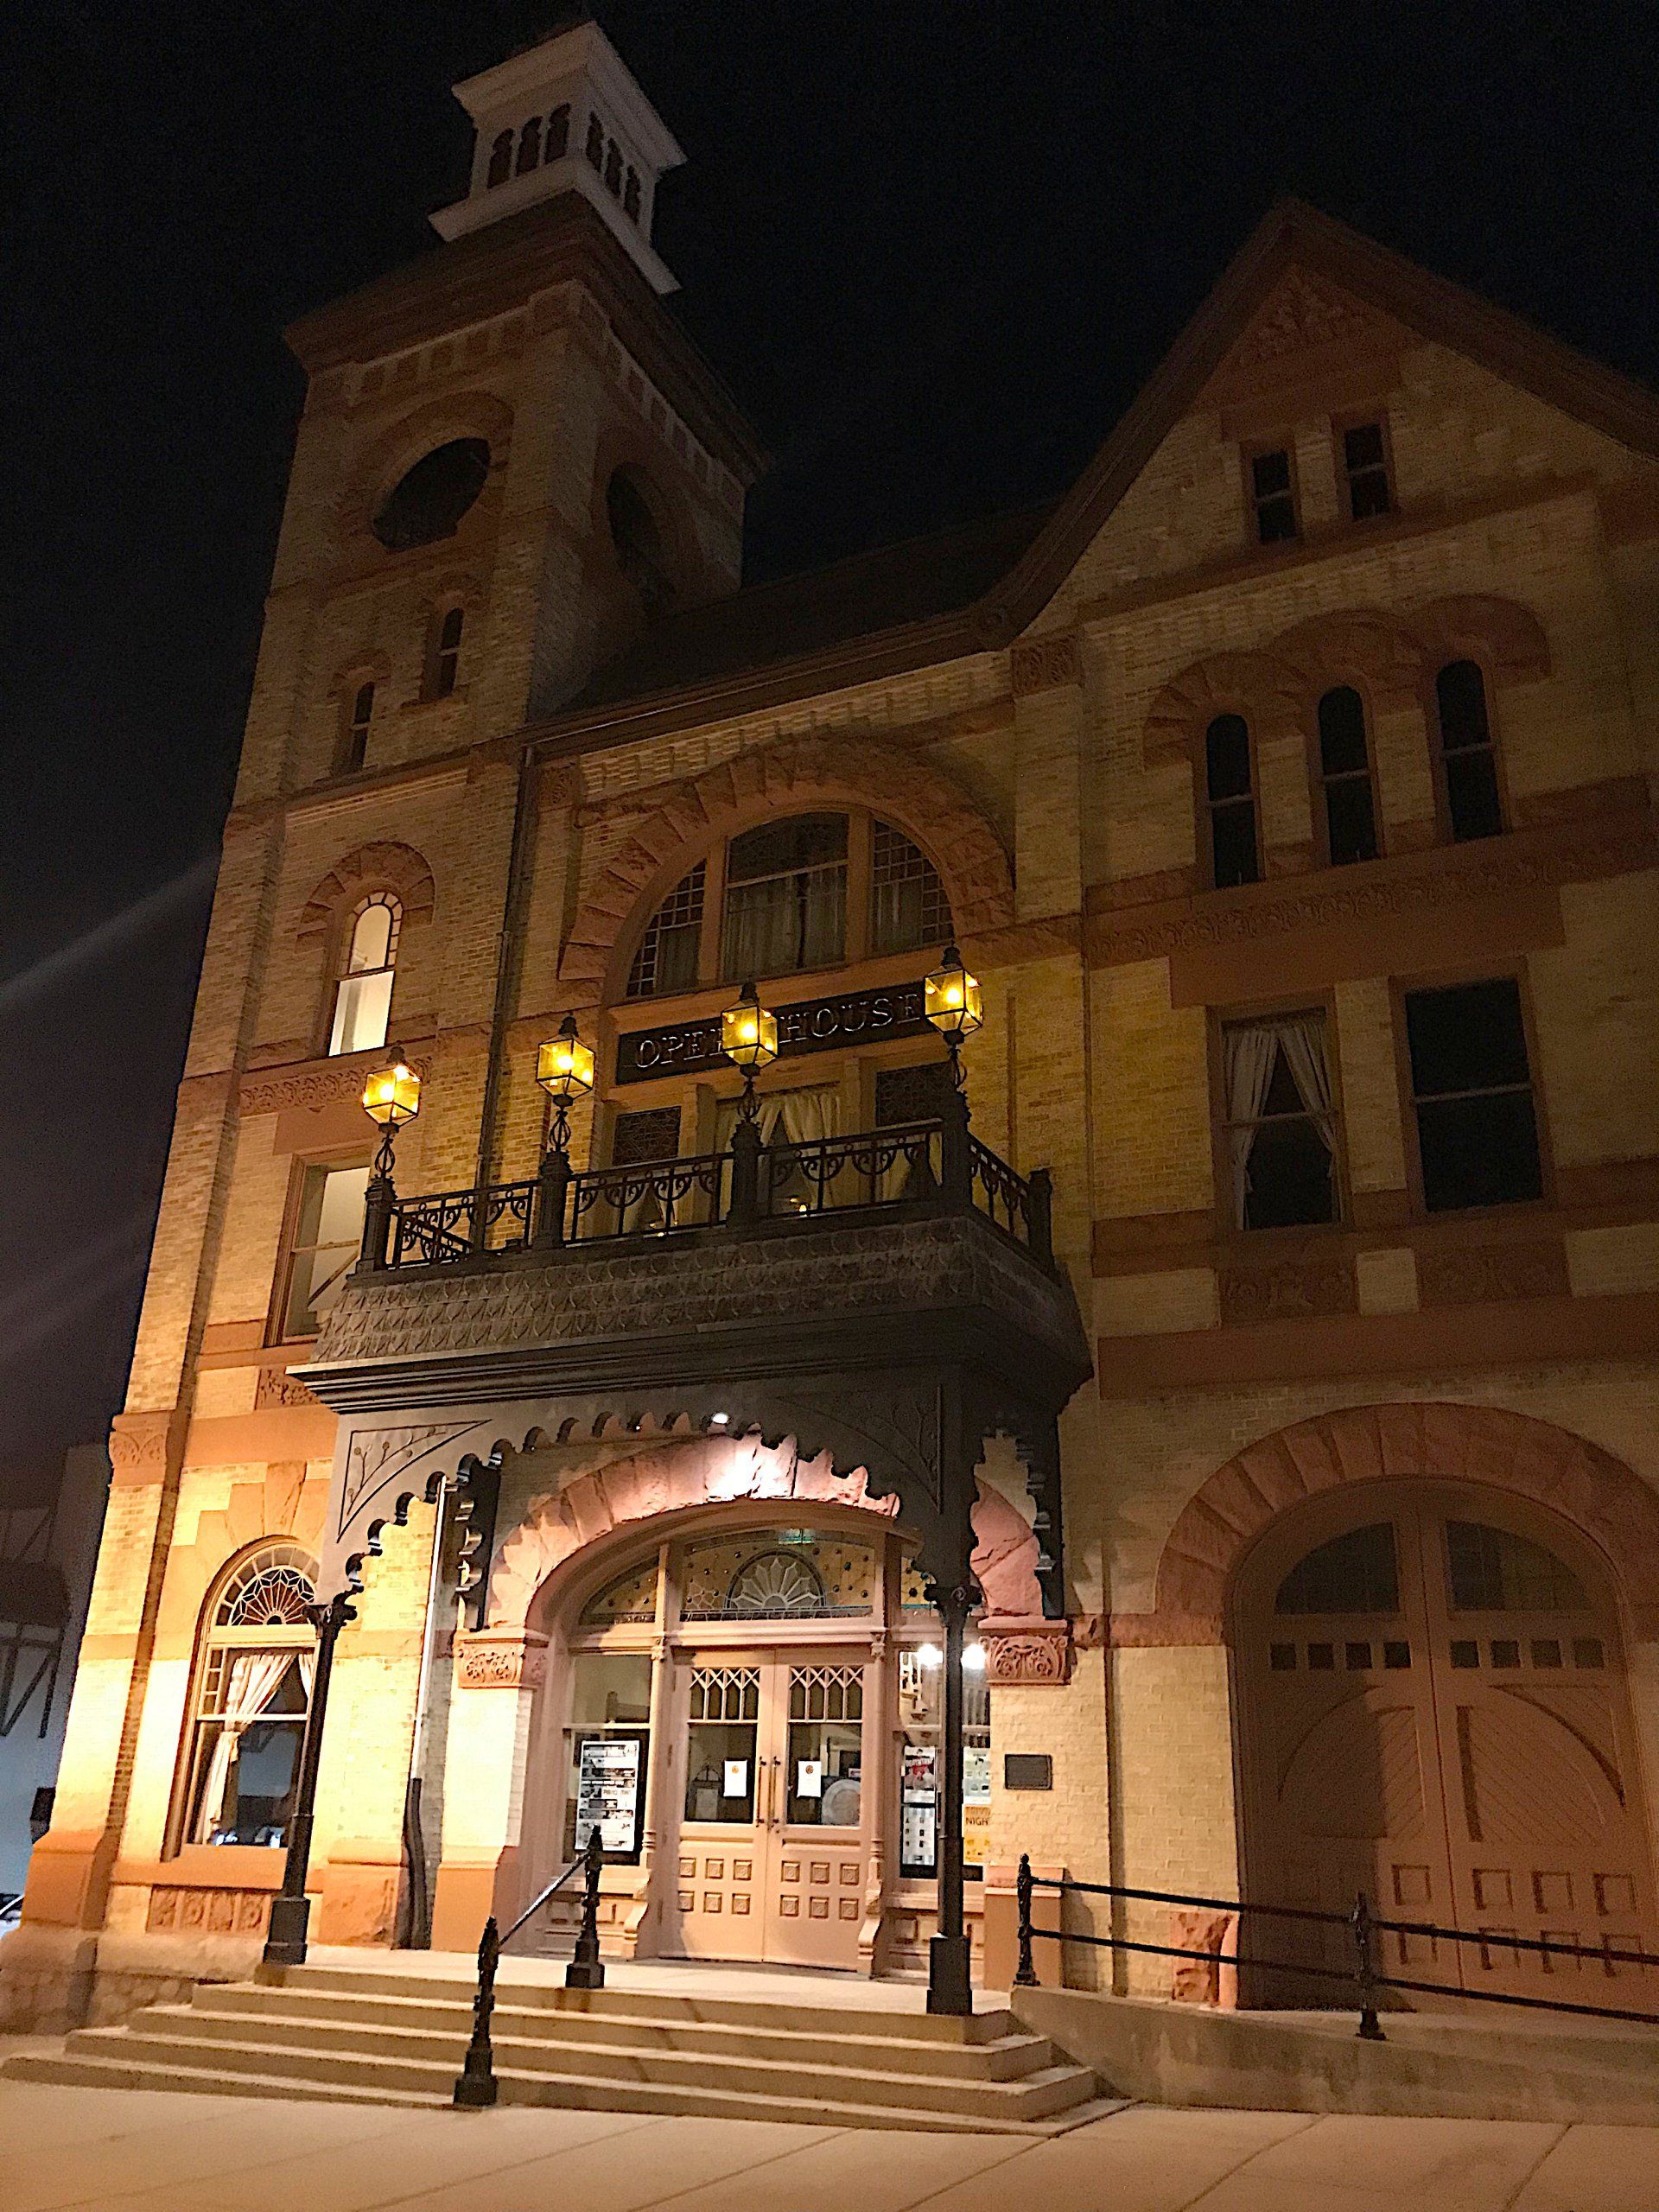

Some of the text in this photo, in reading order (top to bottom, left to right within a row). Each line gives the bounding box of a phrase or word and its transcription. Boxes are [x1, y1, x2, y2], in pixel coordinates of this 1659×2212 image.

[636, 993, 921, 1068] OPE HOUSE
[965, 1816, 989, 1826] NIGH
